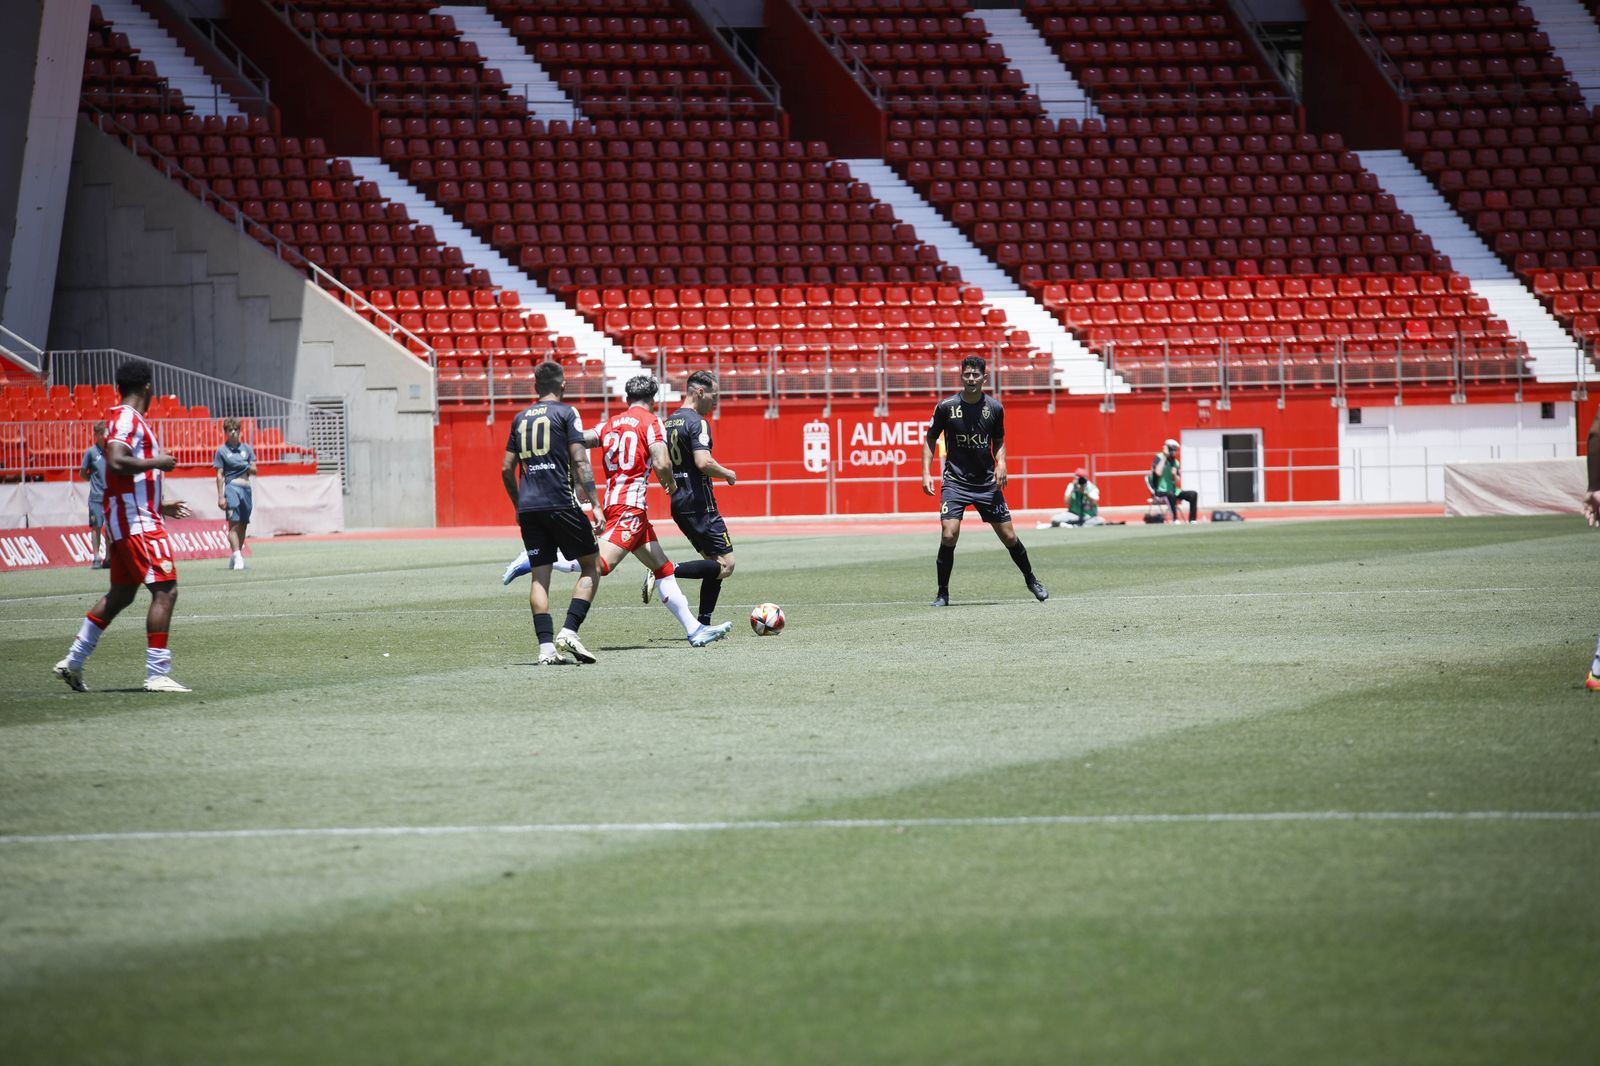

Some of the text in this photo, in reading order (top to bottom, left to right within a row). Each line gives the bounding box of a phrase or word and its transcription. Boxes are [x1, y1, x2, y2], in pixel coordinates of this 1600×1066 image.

[525, 407, 547, 417] ADRI
[950, 405, 963, 419] 16
[517, 415, 551, 460] 10
[603, 430, 638, 471] 20
[849, 449, 907, 466] CIUDAD
[619, 511, 642, 533] 20
[0, 536, 49, 567] LALIGA
[149, 538, 171, 559] 11
